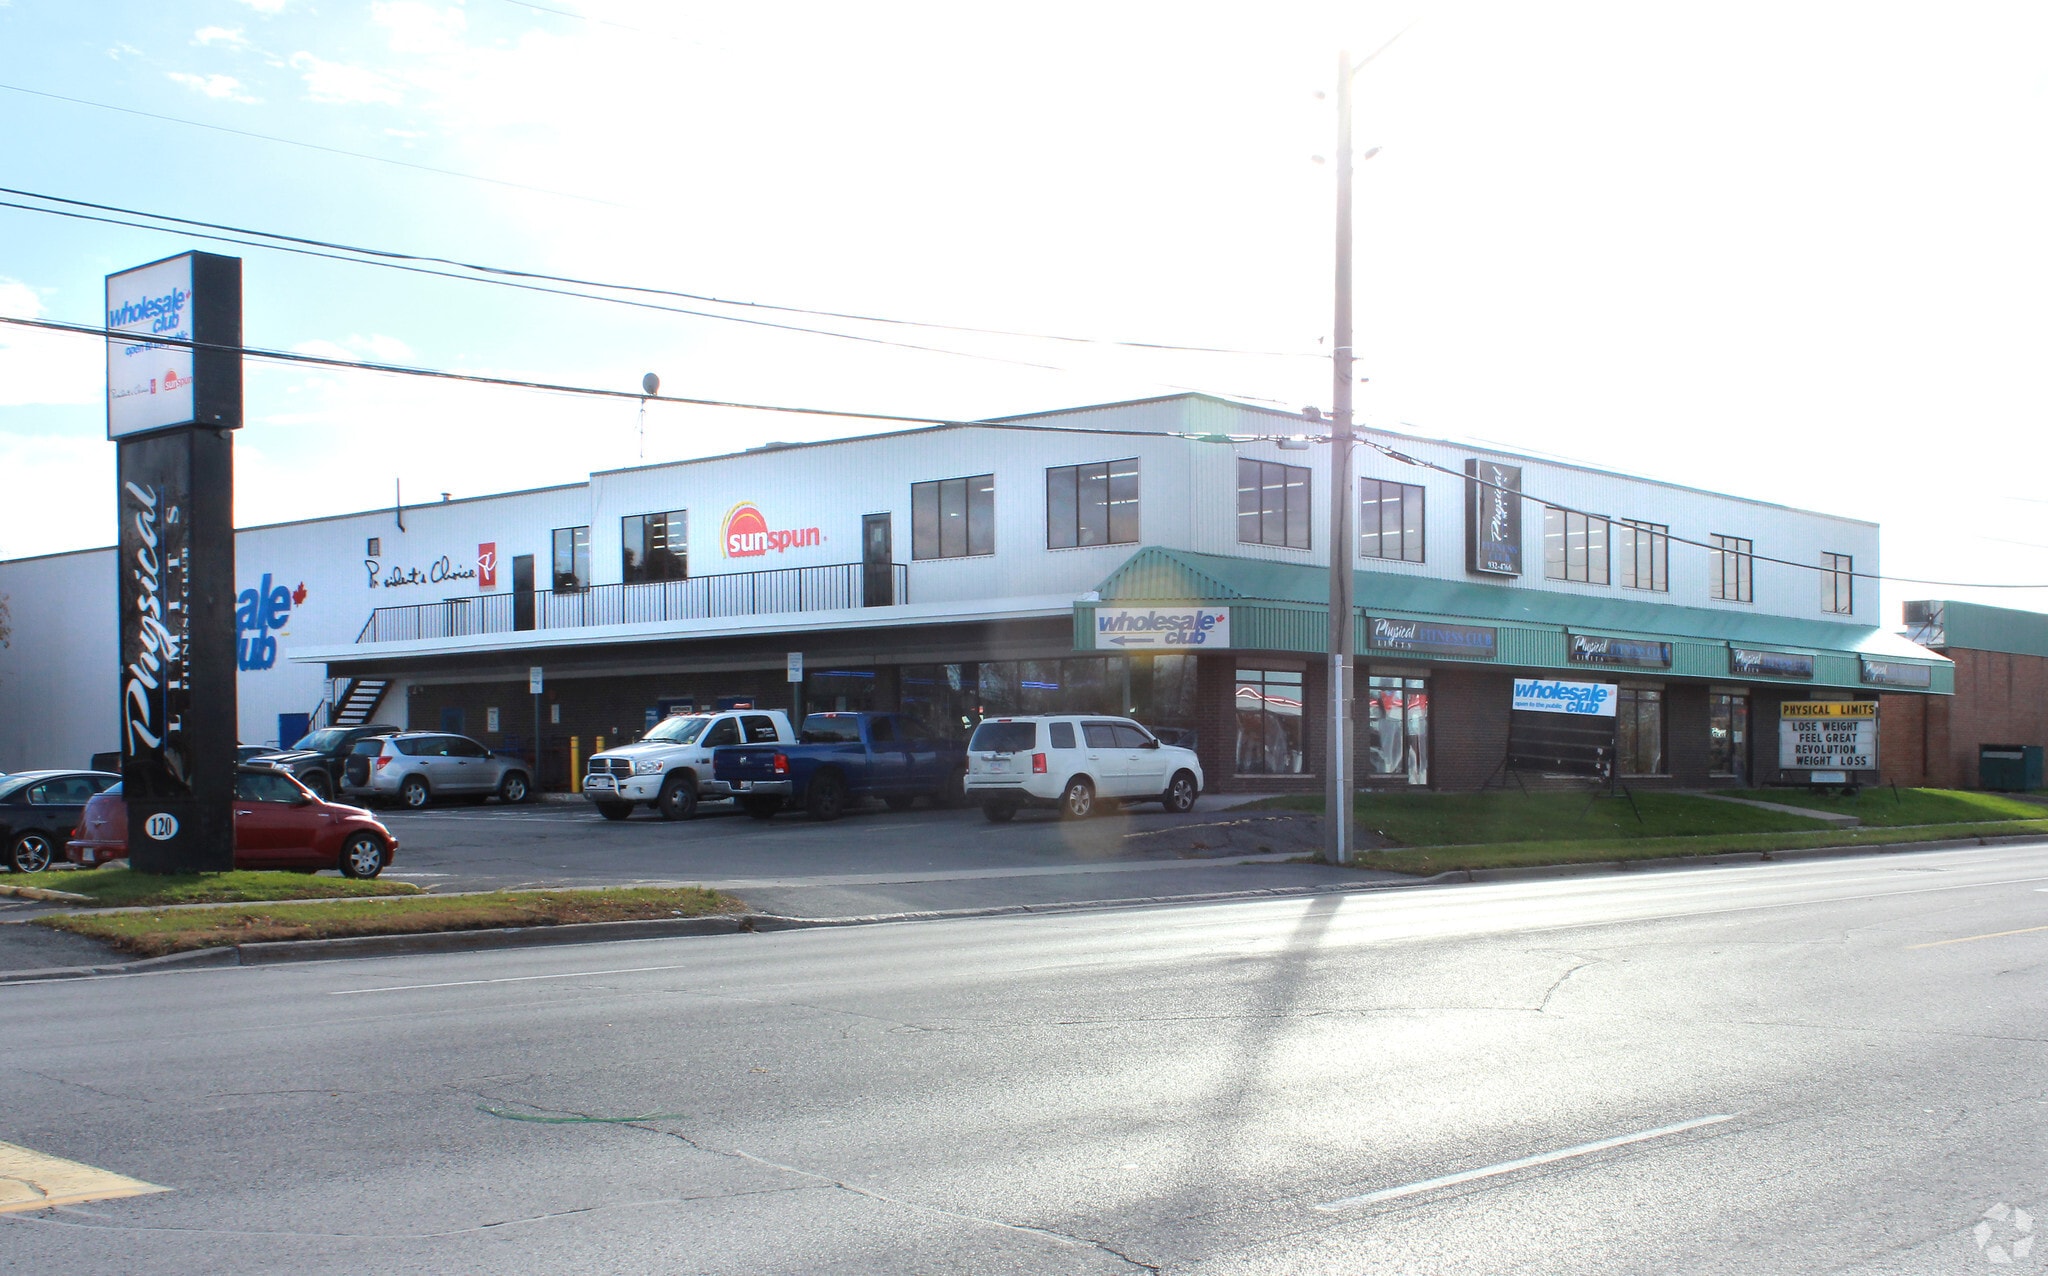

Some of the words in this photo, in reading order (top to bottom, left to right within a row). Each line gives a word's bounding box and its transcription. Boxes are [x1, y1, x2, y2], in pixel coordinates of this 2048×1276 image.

[109, 287, 185, 327] wholesale
[153, 313, 180, 333] club
[729, 526, 820, 554] sunspun
[431, 555, 477, 583] Choice
[125, 481, 172, 756] Physical
[167, 505, 181, 731] LIMITS
[1098, 610, 1216, 632] wholesale
[1164, 627, 1206, 645] club
[1375, 618, 1416, 643] Physical
[1574, 635, 1608, 657] Physical
[1515, 680, 1608, 702] wholesale
[1566, 700, 1599, 714] club
[1783, 705, 1830, 715] PHYSICAL
[1840, 705, 1875, 715] LIMITS
[1792, 721, 1817, 732] LOSE
[1822, 721, 1858, 731] WEIGHT
[1799, 733, 1822, 743] FEEL
[1825, 733, 1857, 743] GREAT
[1795, 744, 1856, 754] REVOLUTION
[1796, 755, 1832, 765] WEIGHT
[1840, 755, 1867, 766] LOSS
[152, 817, 172, 836] 120
